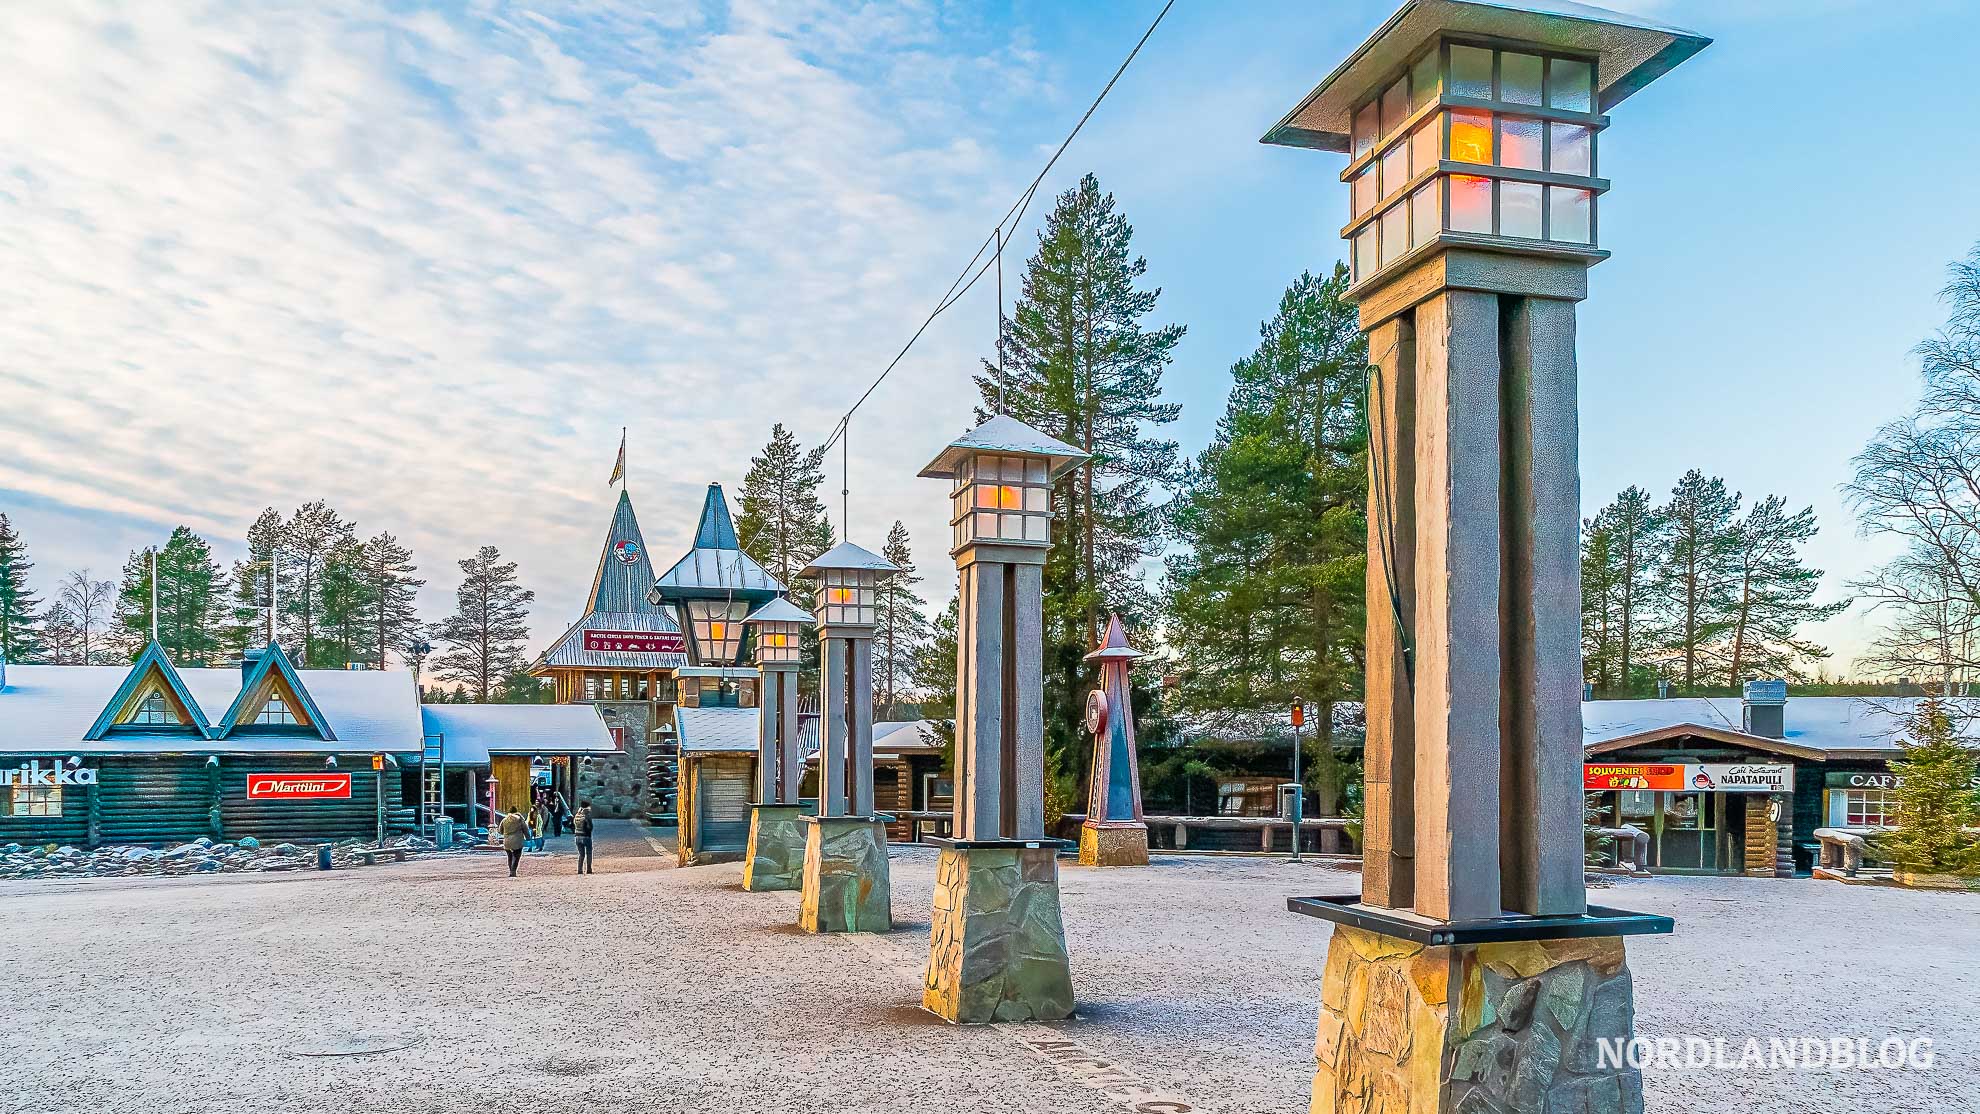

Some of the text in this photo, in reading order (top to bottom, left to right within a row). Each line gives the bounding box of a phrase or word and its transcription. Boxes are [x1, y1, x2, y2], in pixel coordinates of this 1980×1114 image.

[0, 759, 99, 785] rikka
[1589, 766, 1645, 776] SOUVENIRS
[1721, 775, 1782, 785] NAPATAPULI
